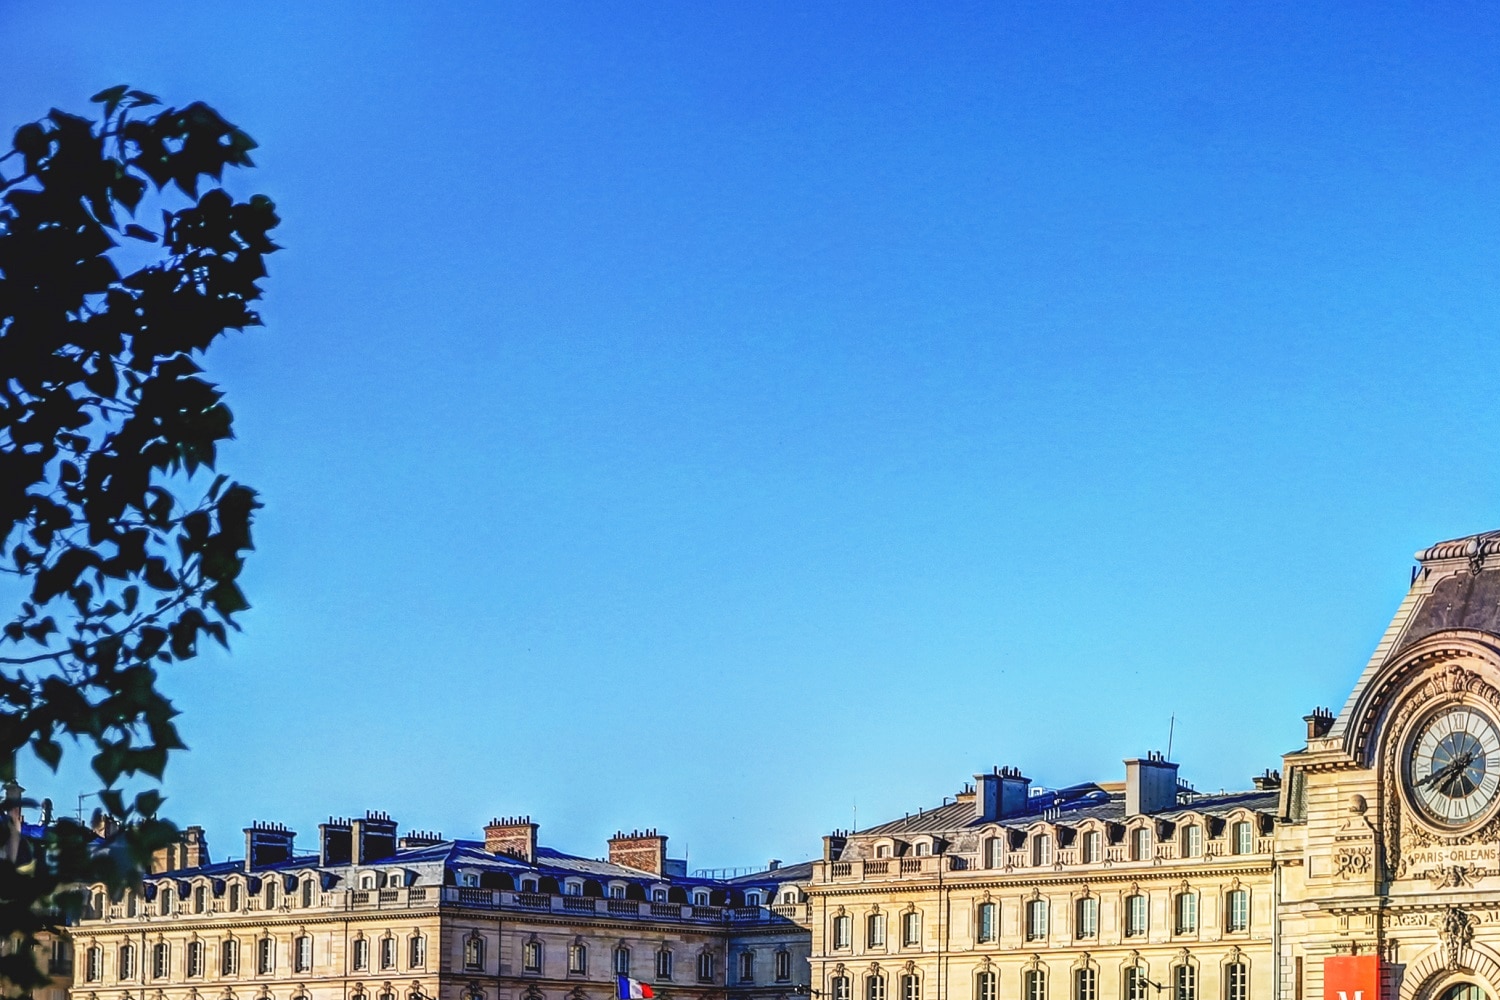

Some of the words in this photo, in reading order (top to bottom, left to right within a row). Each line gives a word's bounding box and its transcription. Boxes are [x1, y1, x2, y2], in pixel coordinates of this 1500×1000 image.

[1436, 720, 1448, 738] XI
[1453, 714, 1464, 730] XII
[1472, 719, 1480, 733] I
[1422, 739, 1435, 751] X
[1483, 735, 1495, 747] II
[1418, 762, 1430, 773] IX
[1487, 758, 1500, 768] III
[1454, 801, 1464, 817] VI
[1473, 795, 1481, 810] V
[1338, 853, 1366, 869] PO
